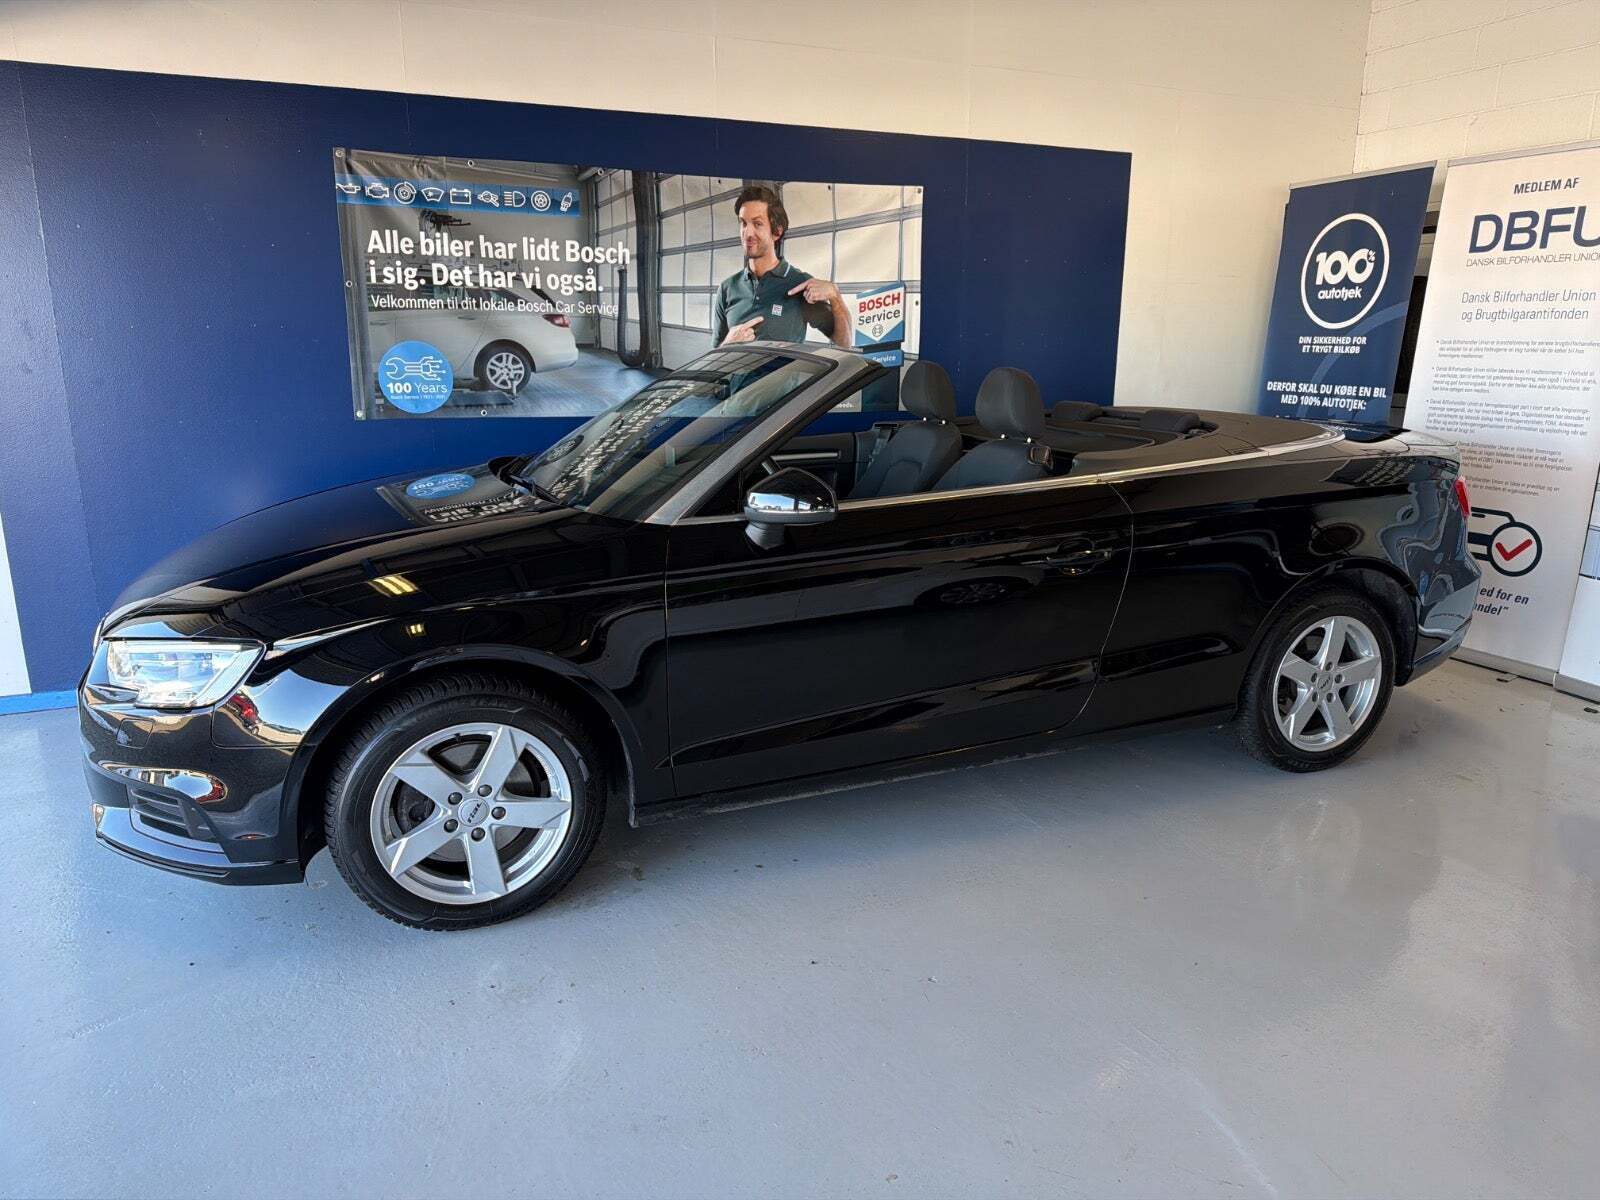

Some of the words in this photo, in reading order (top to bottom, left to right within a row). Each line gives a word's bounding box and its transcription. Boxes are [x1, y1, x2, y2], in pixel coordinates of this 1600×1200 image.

[1513, 179, 1561, 195] MEDLEM
[1563, 177, 1580, 189] AF
[1468, 205, 1600, 254] DBFU
[367, 229, 415, 255] Alle
[420, 231, 474, 257] biler
[479, 234, 517, 259] har
[522, 236, 560, 262] lidt
[565, 239, 631, 265] Bosch
[1466, 257, 1494, 267] DANSK
[1496, 253, 1572, 266] BILFORHANDLER
[369, 259, 377, 284] i
[382, 260, 426, 291] sig.
[431, 262, 474, 287] Det
[479, 263, 517, 288] har
[521, 266, 542, 290] vi
[546, 267, 604, 296] også.
[1317, 286, 1362, 302] autotjek
[1461, 291, 1490, 304] Dansk
[1493, 289, 1560, 303] Bilforhandler
[1562, 289, 1597, 302] Union
[371, 294, 444, 310] Velkommen
[447, 296, 458, 310] til
[461, 296, 478, 311] dit
[480, 297, 515, 312] lokale
[517, 298, 553, 313] Bosch
[555, 300, 575, 314] Car
[578, 300, 618, 316] Service
[858, 292, 901, 314] BOSCH
[858, 309, 901, 326] Service
[1461, 311, 1473, 323] og
[1475, 308, 1589, 323] Brugtbilgarantifonden
[1299, 336, 1312, 345] DIN
[1313, 335, 1351, 345] SIKKERHED
[1352, 336, 1367, 345] FOR
[1302, 345, 1311, 353] ET
[1312, 345, 1332, 353] TRYGT
[1333, 345, 1360, 354] BILKØB
[387, 382, 412, 394] 100
[414, 382, 448, 394] Years
[1267, 381, 1296, 392] DERFOR
[1298, 382, 1318, 394] SKAL
[1320, 384, 1332, 395] DU
[1334, 385, 1357, 396] KØBE
[1359, 386, 1371, 398] EN
[1372, 387, 1387, 399] BIL
[1280, 394, 1298, 405] MED
[1300, 395, 1321, 407] 100%
[1322, 397, 1367, 412] AUTOTJEK:
[1496, 588, 1513, 601] for
[1514, 595, 1529, 605] en
